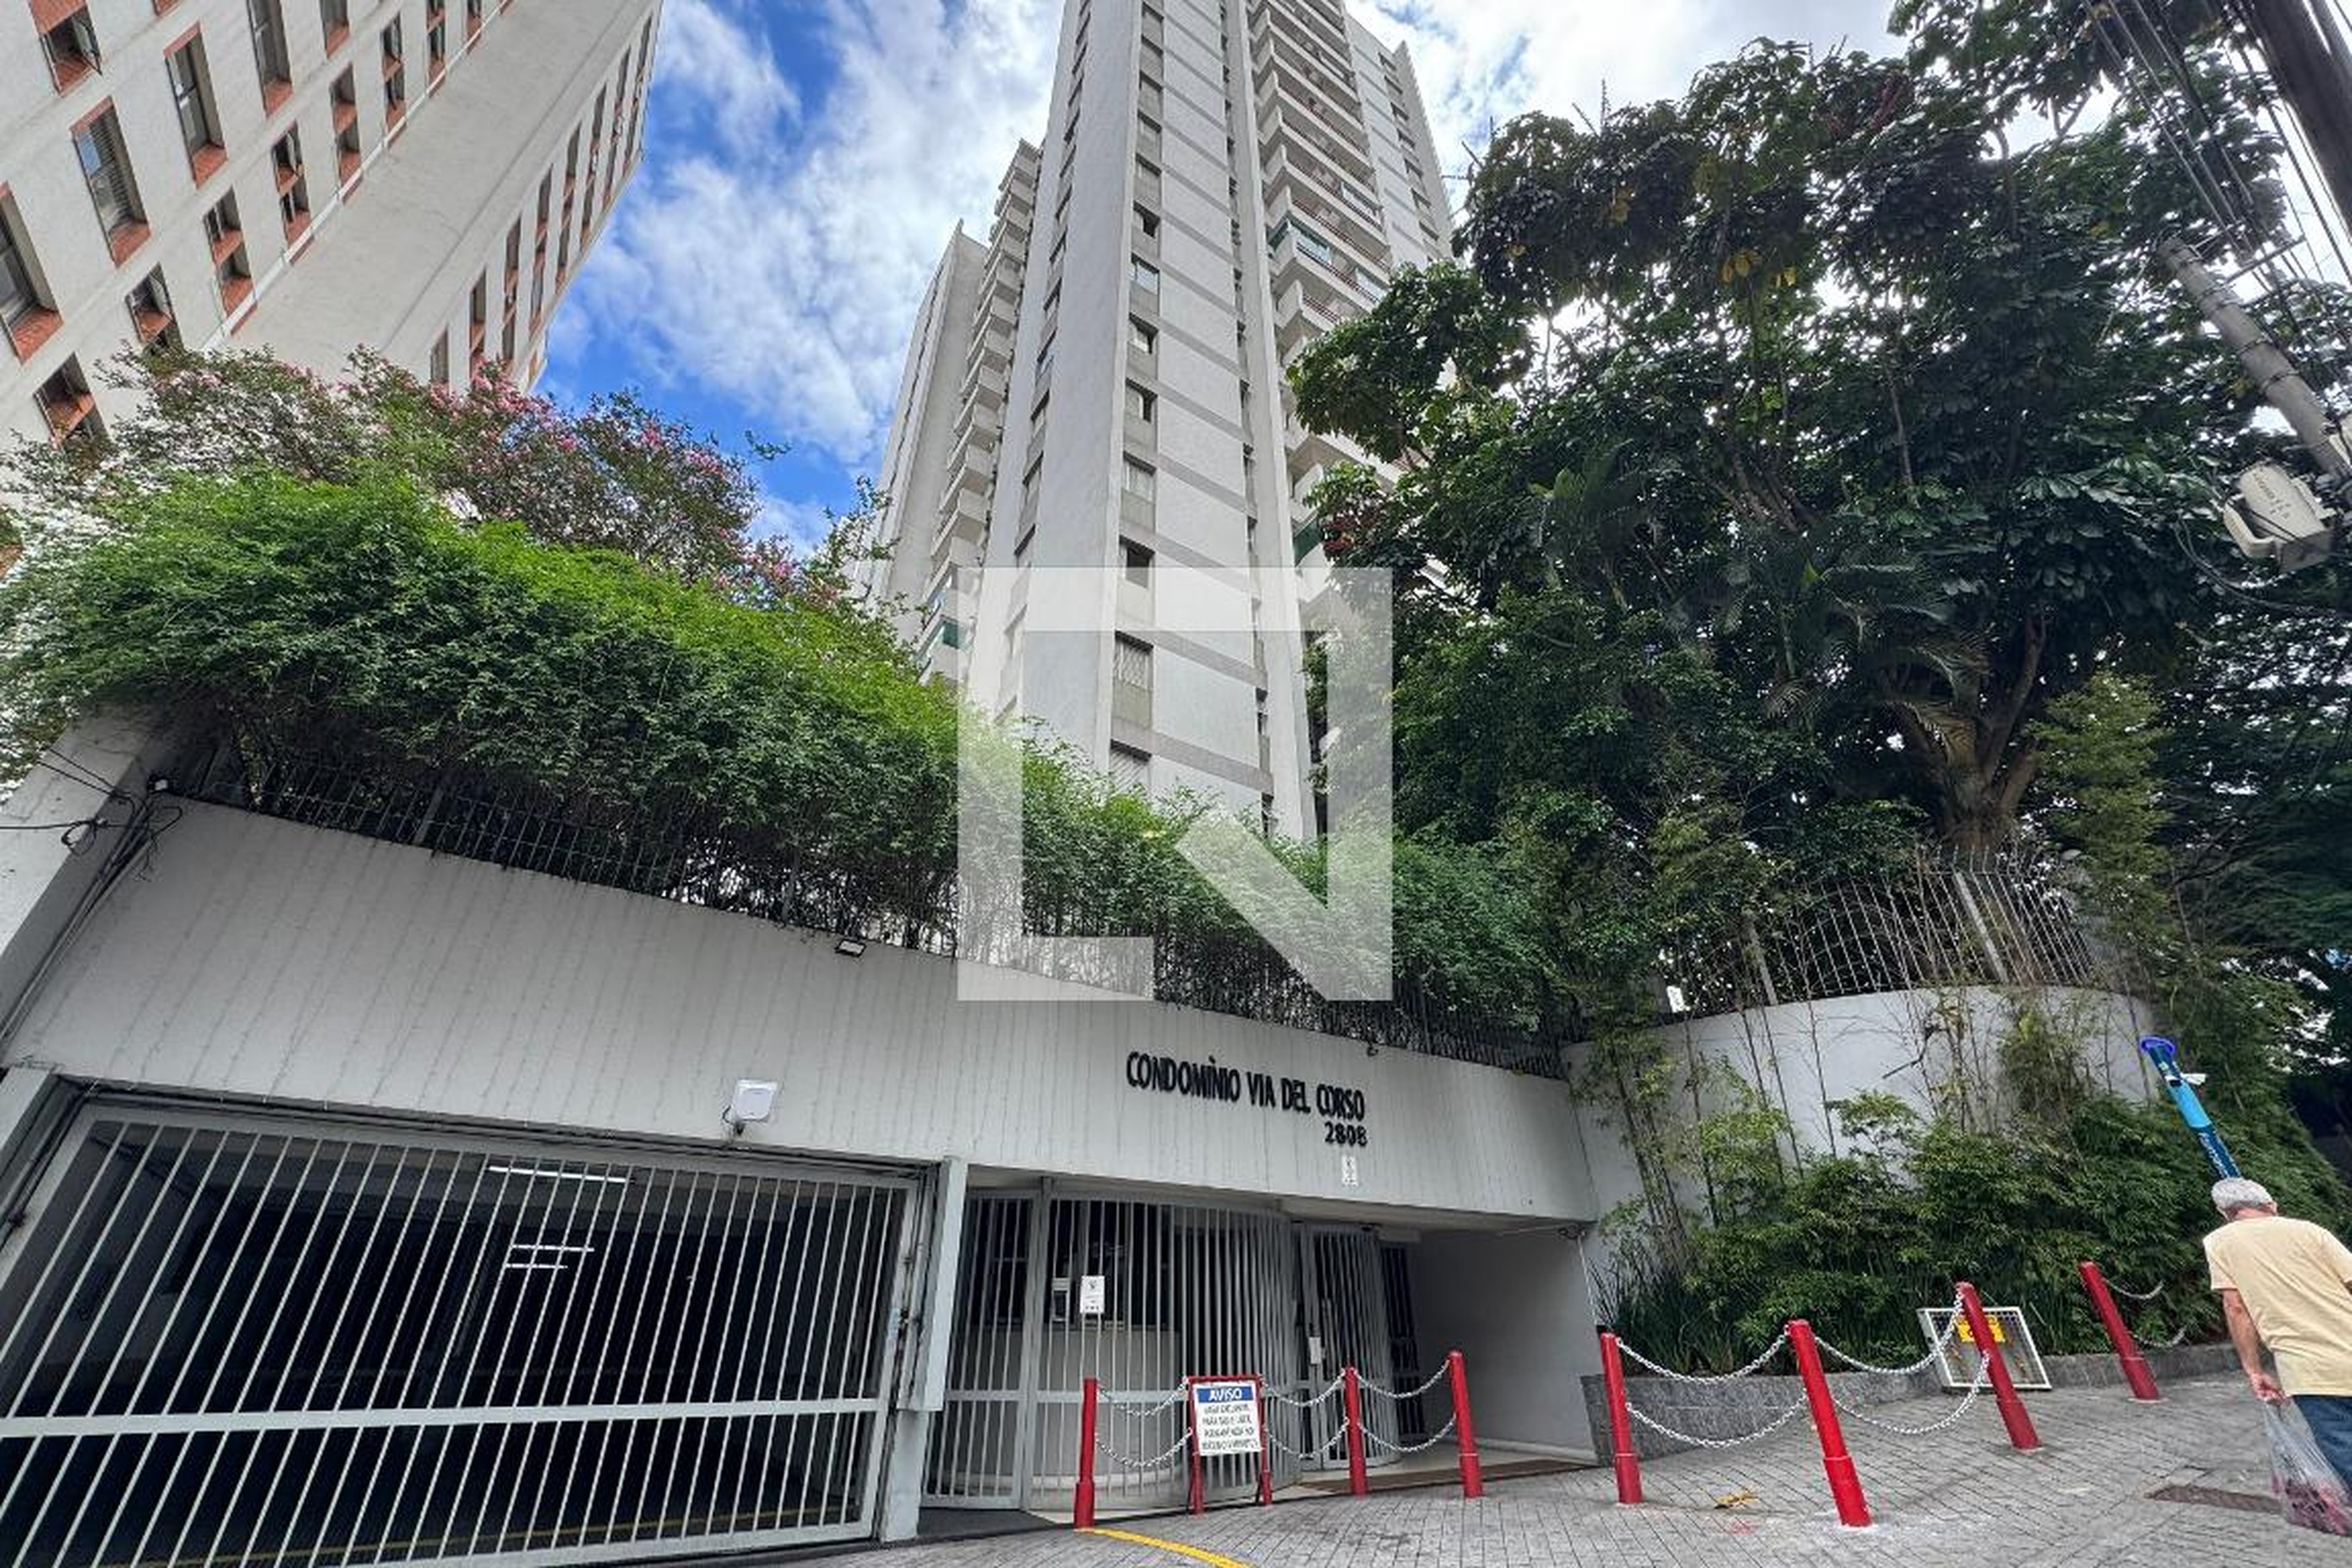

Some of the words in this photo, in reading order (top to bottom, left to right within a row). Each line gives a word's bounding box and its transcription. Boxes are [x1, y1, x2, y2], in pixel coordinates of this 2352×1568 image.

[1246, 1071, 1276, 1108] VIA
[1281, 1077, 1311, 1114] DEL
[1317, 1084, 1365, 1121] CORSO
[1324, 1121, 1368, 1147] 2808
[1208, 1387, 1243, 1401] AVISO
